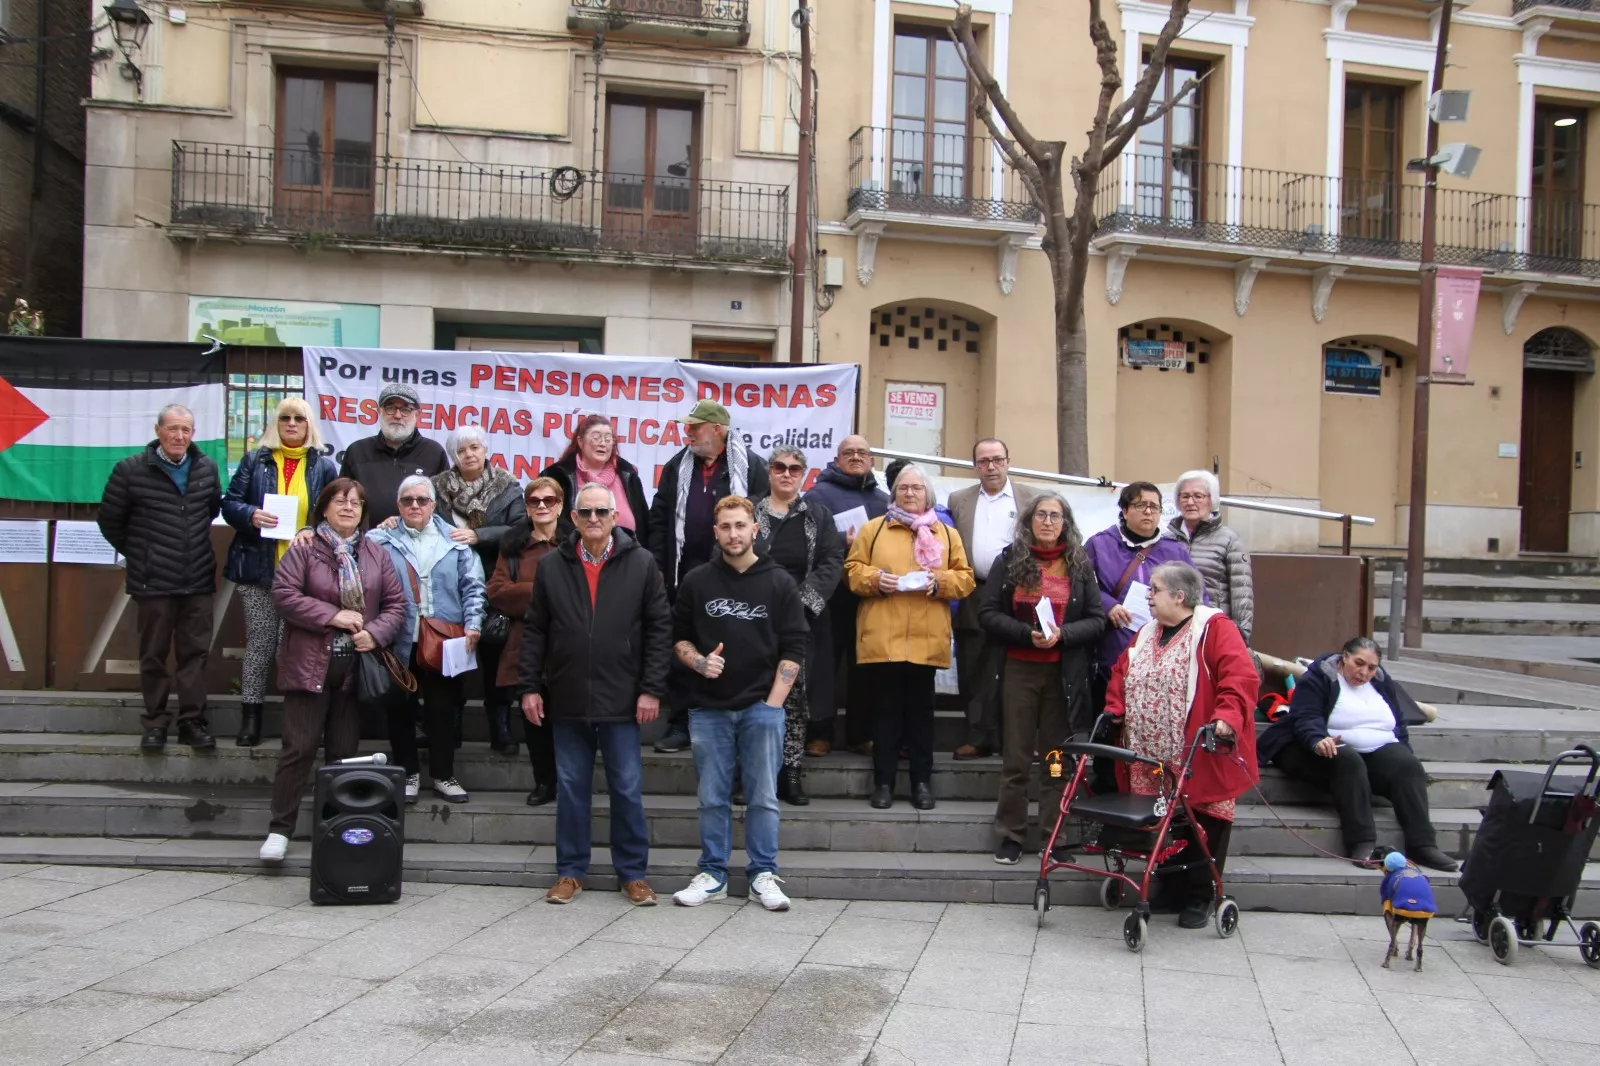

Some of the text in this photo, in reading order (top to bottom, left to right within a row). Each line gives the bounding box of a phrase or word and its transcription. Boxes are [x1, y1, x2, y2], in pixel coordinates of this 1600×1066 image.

[319, 356, 837, 408] Por unas PENSIONES DIGNAS
[890, 391, 935, 406] SE VENDE
[318, 394, 533, 436] RESENCIAS
[760, 427, 833, 450] calidad
